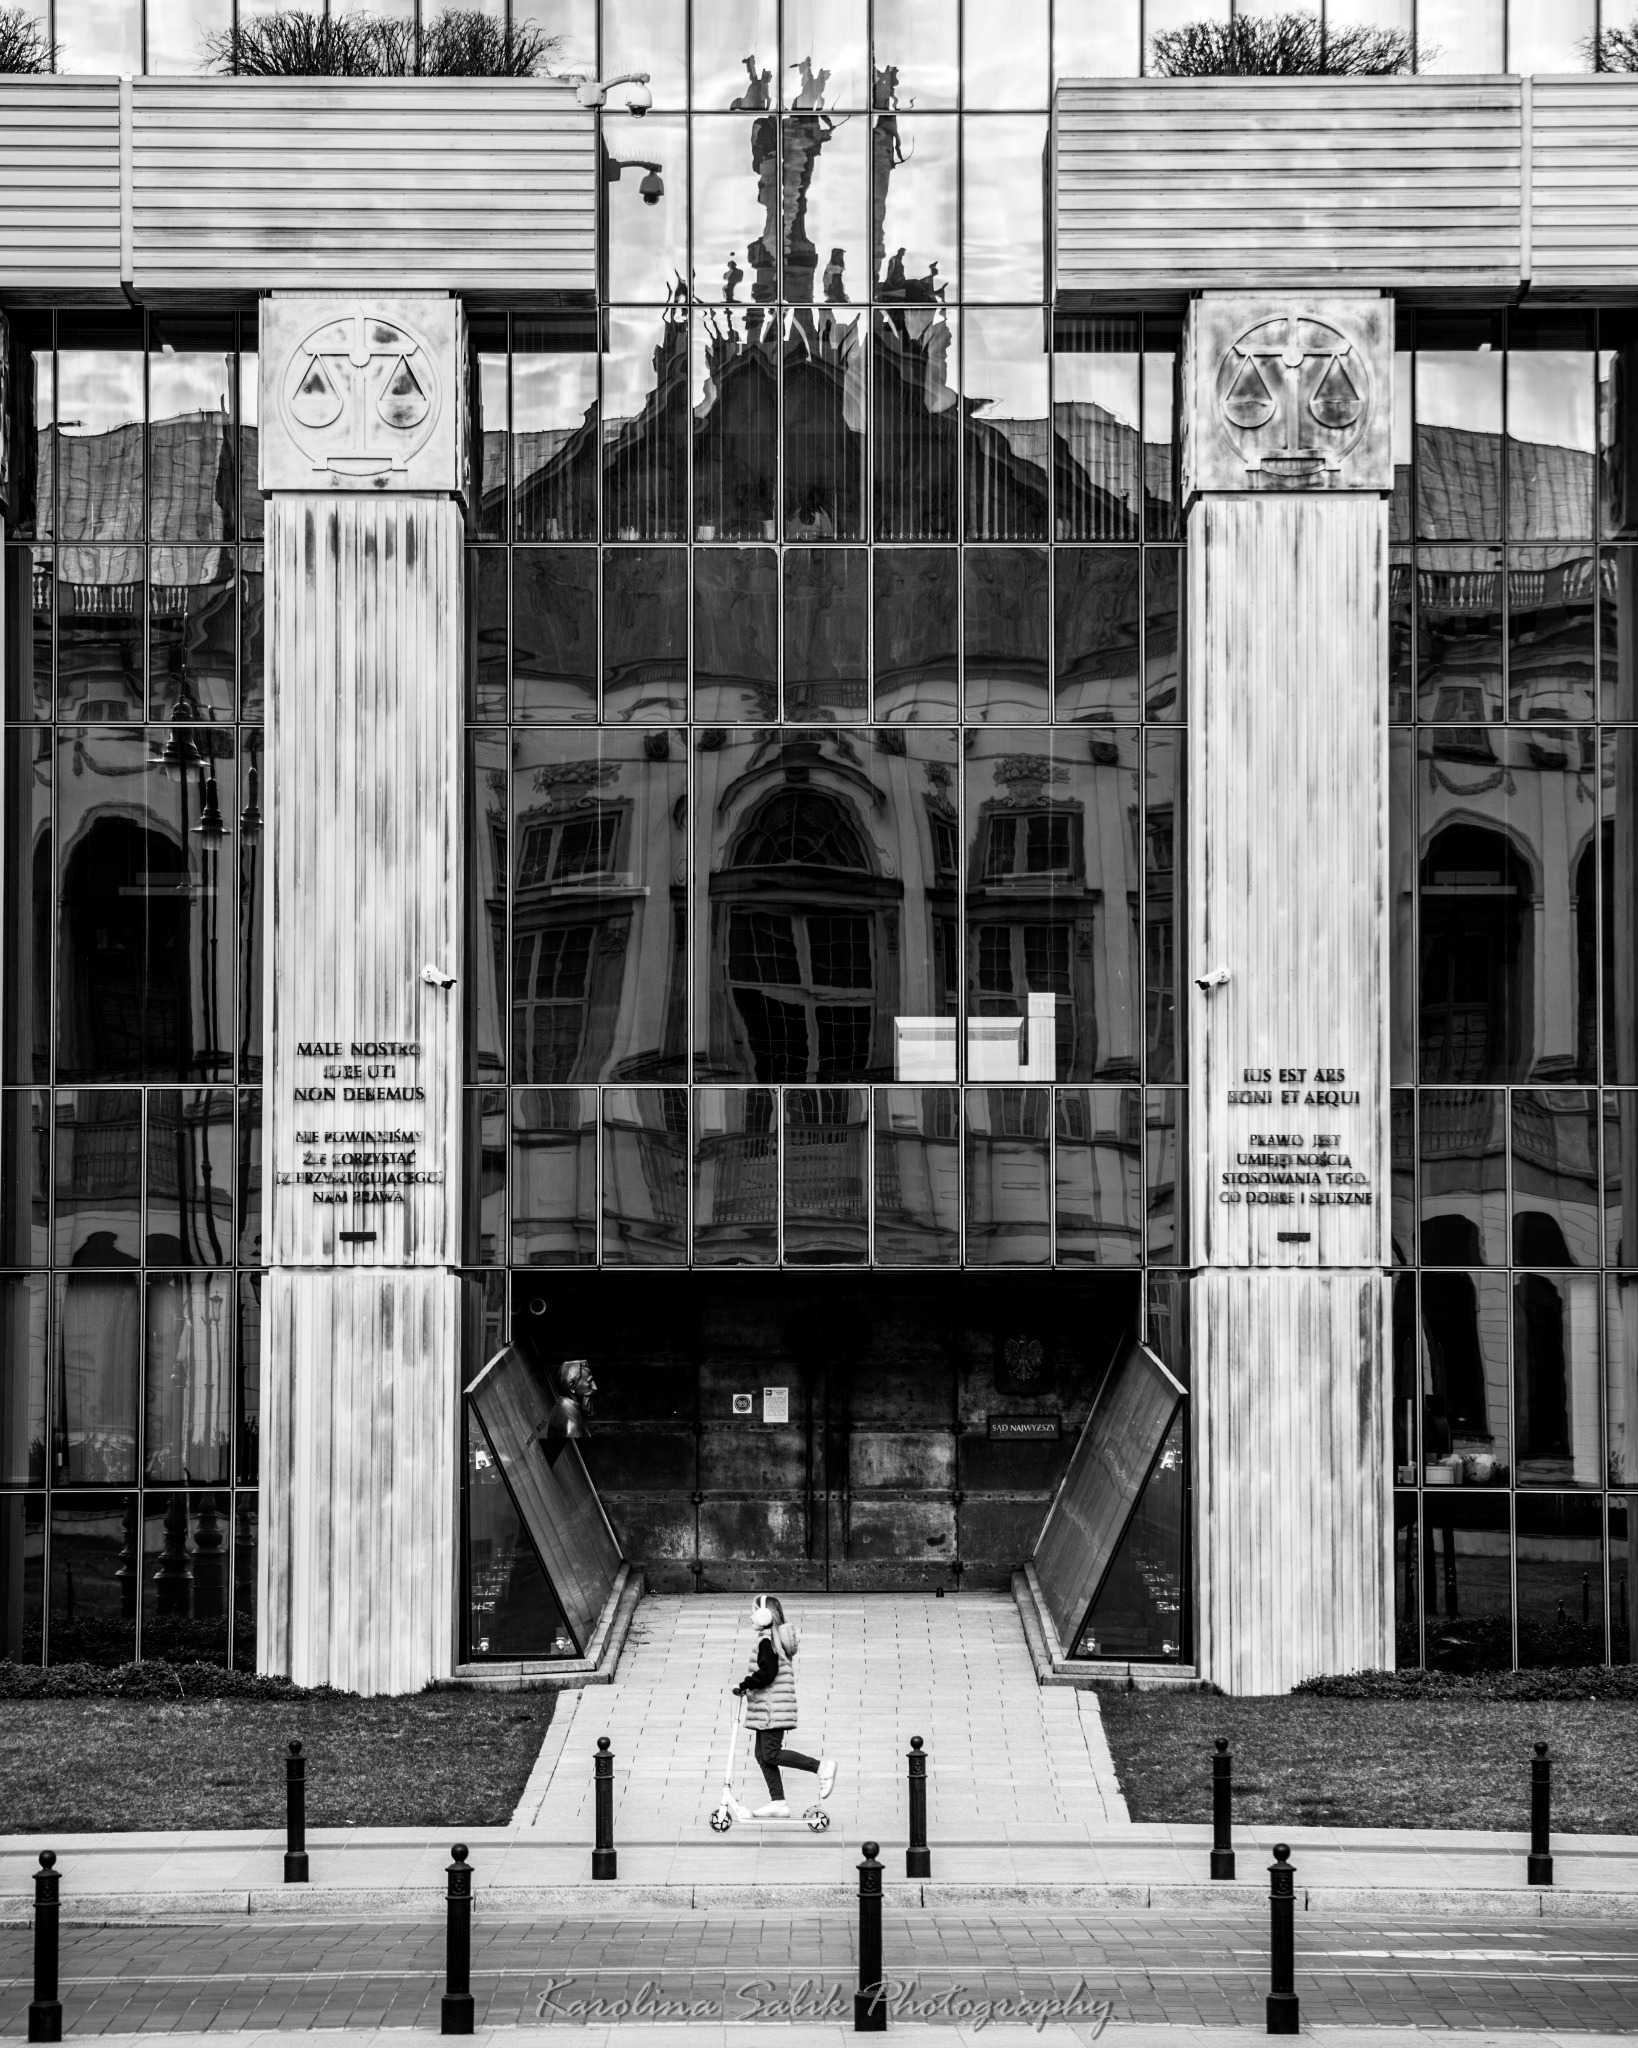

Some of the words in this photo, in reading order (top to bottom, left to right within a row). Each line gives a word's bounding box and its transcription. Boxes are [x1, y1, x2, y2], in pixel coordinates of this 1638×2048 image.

[297, 1042, 342, 1056] MALE
[351, 1042, 423, 1056] NOSTRO
[323, 1065, 362, 1078] IURE
[367, 1065, 396, 1078] UTI
[1243, 1069, 1272, 1082] IUS
[1279, 1069, 1307, 1082] EST
[1314, 1069, 1345, 1082] ARS
[294, 1087, 336, 1101] NON
[343, 1087, 425, 1101] DEBEMUS
[1228, 1090, 1272, 1104] BONI
[1281, 1090, 1300, 1104] ET
[1304, 1090, 1360, 1107] AEQUI
[295, 1131, 319, 1143] NIE
[324, 1128, 423, 1143] POWINNIŚMY
[1250, 1134, 1304, 1146] PRAWO
[1312, 1134, 1341, 1147] JEST
[333, 1149, 416, 1165] KORZYSTAĆ
[1222, 1172, 1321, 1185] STOSOWANIA
[313, 1191, 347, 1203] NAM
[353, 1190, 404, 1203] PRAWA
[1219, 1191, 1242, 1203] CO
[1246, 1191, 1295, 1204] DOBRE
[1309, 1192, 1373, 1205] SŁUSZNE
[992, 1424, 1009, 1434] SĄD
